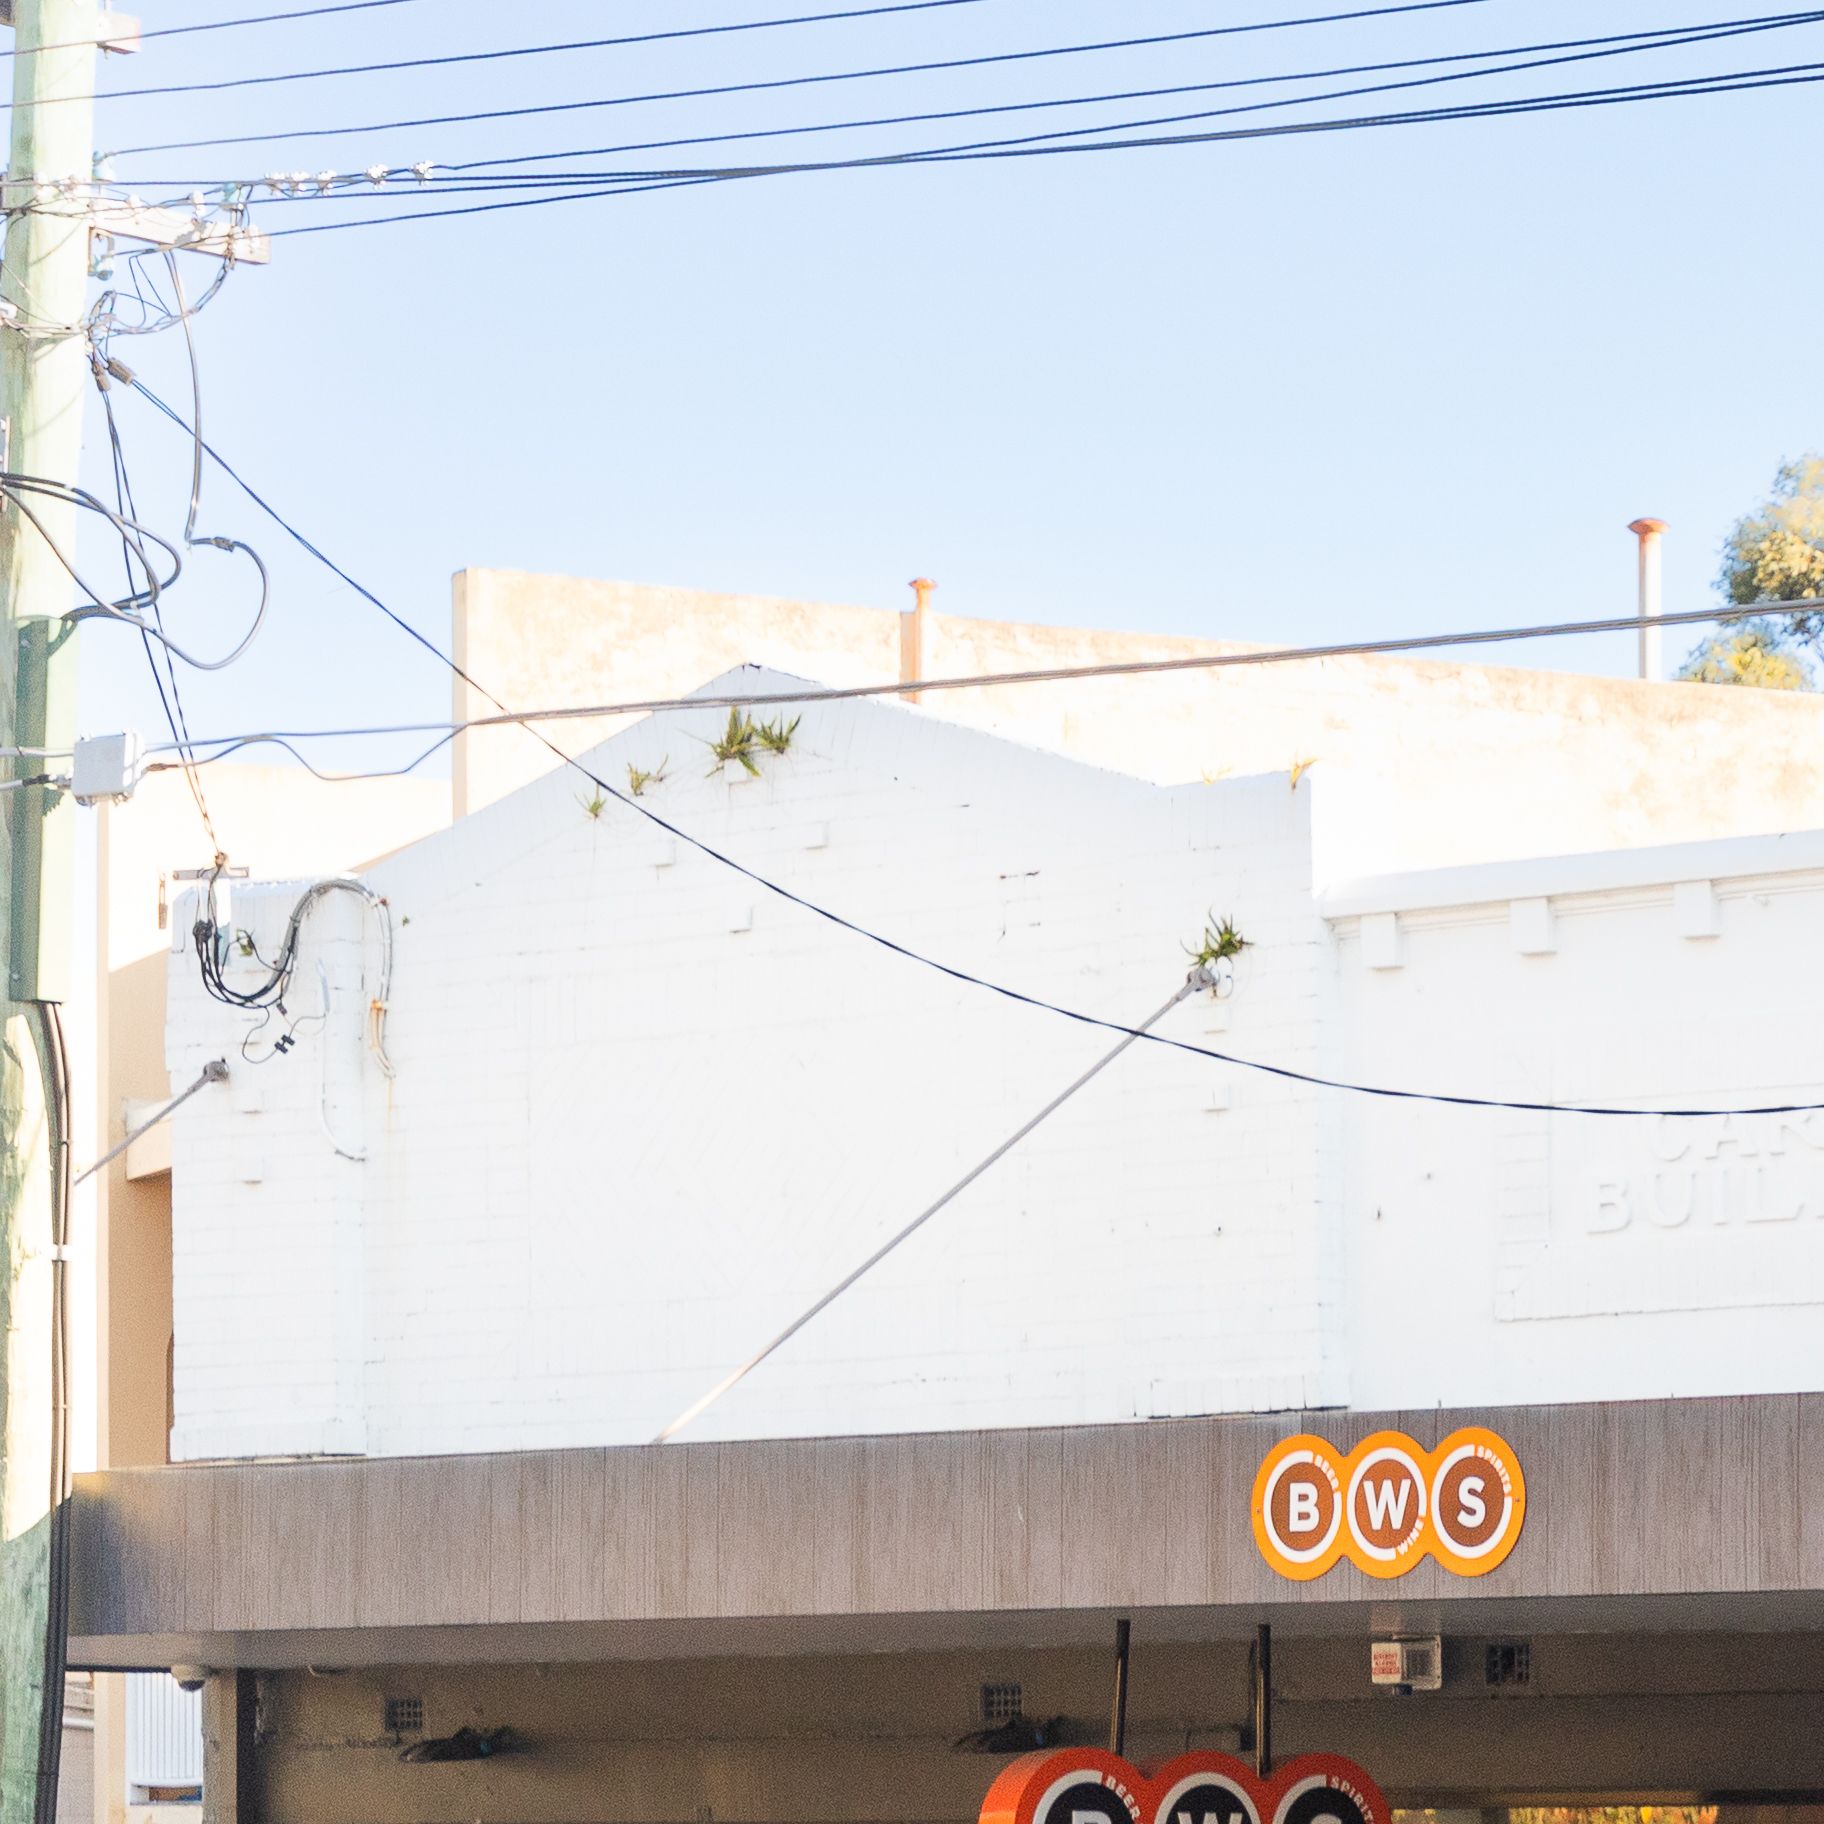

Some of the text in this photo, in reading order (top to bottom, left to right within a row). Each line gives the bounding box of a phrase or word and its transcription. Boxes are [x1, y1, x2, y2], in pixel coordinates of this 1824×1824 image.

[1314, 1453, 1340, 1492] BEER
[1476, 1444, 1513, 1495] SPIRITS
[1396, 1518, 1425, 1556] WINE
[1104, 1774, 1143, 1821] BEER
